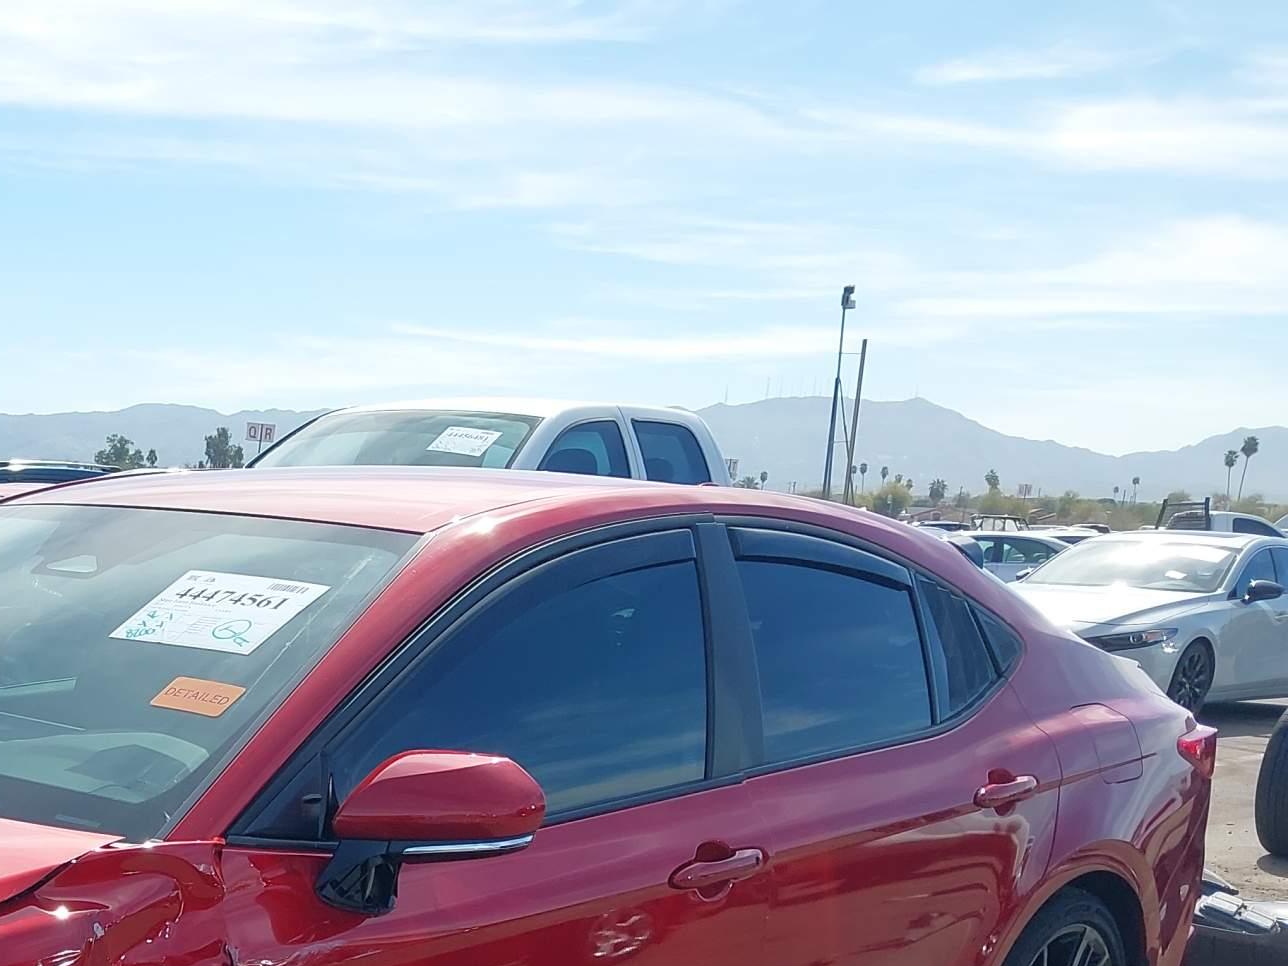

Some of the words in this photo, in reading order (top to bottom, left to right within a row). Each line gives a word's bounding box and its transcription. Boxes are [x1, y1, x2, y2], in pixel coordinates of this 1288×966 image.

[248, 425, 257, 439] Q
[264, 427, 273, 440] R
[175, 586, 290, 610] 44474561
[164, 686, 230, 706] DETAILED
